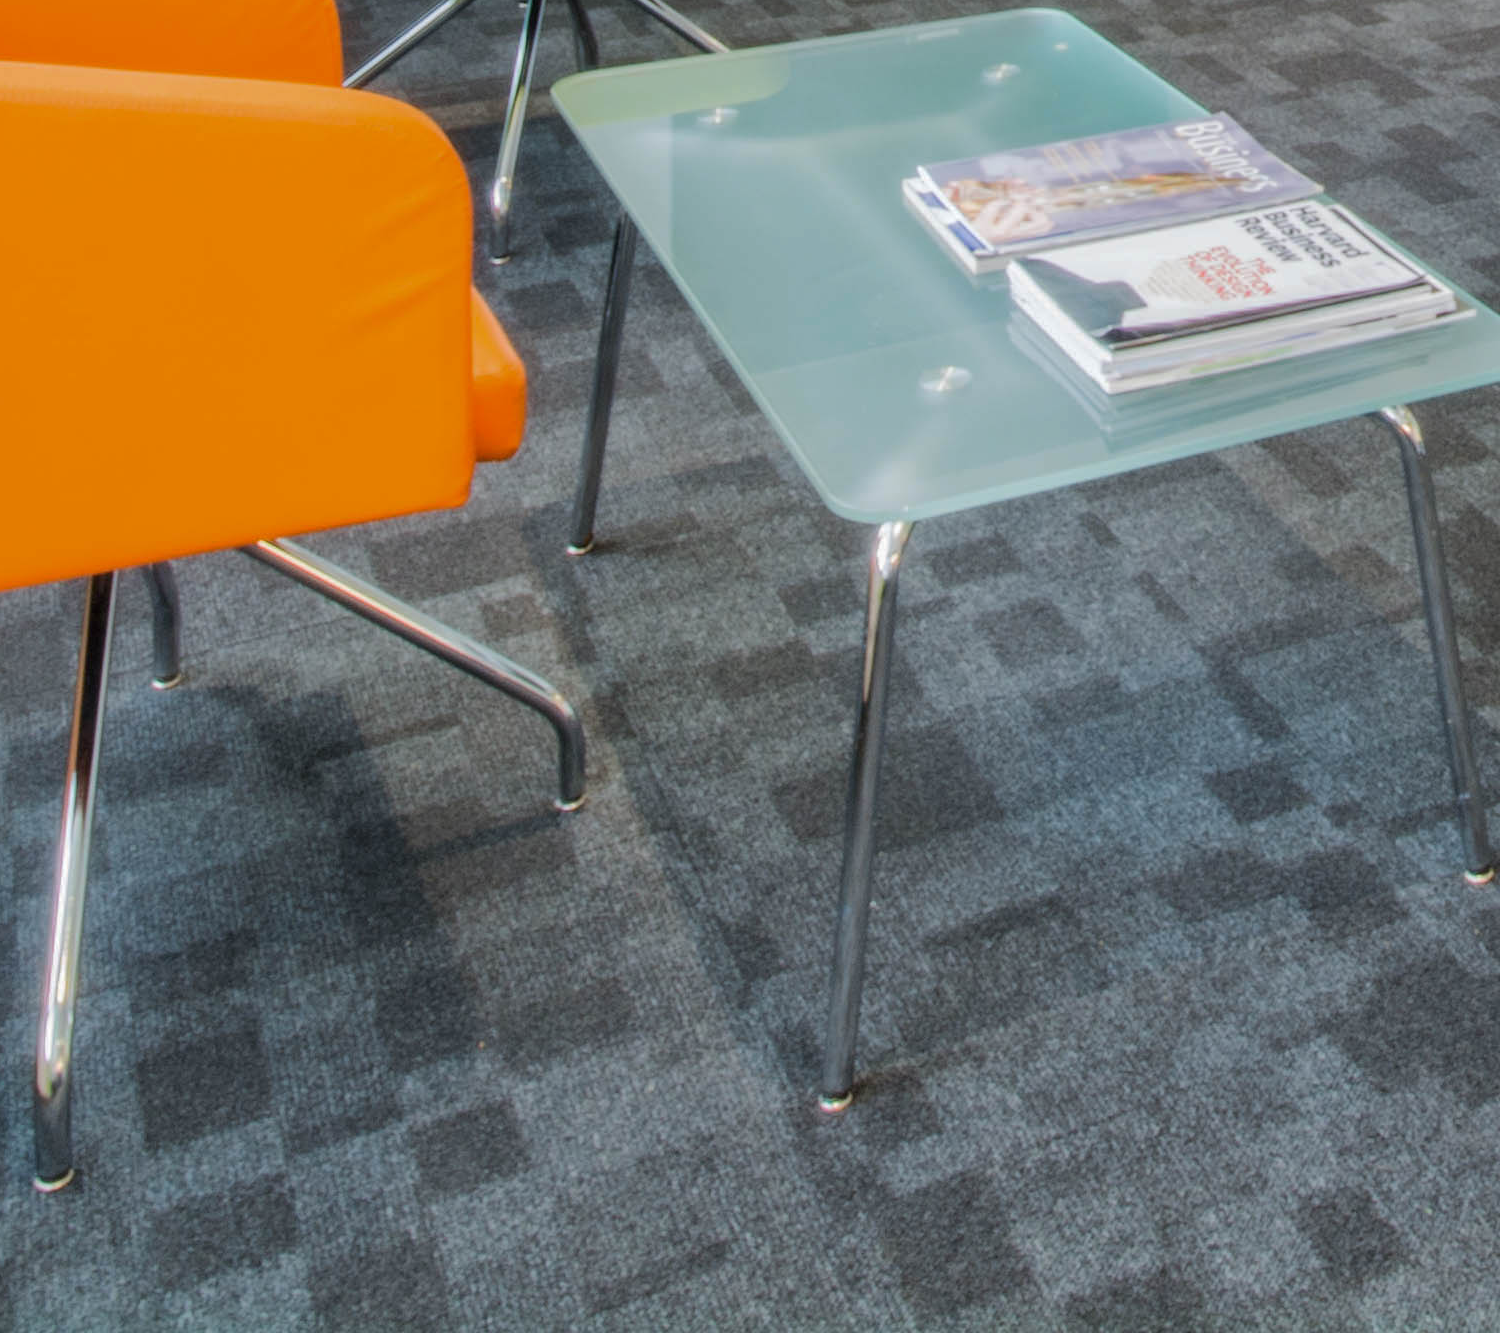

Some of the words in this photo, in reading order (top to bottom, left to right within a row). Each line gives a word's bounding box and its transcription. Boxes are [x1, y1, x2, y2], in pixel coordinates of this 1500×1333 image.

[1174, 120, 1278, 193] Business
[1234, 216, 1304, 262] Review
[1262, 211, 1342, 267] Business
[1288, 204, 1371, 259] Harvard
